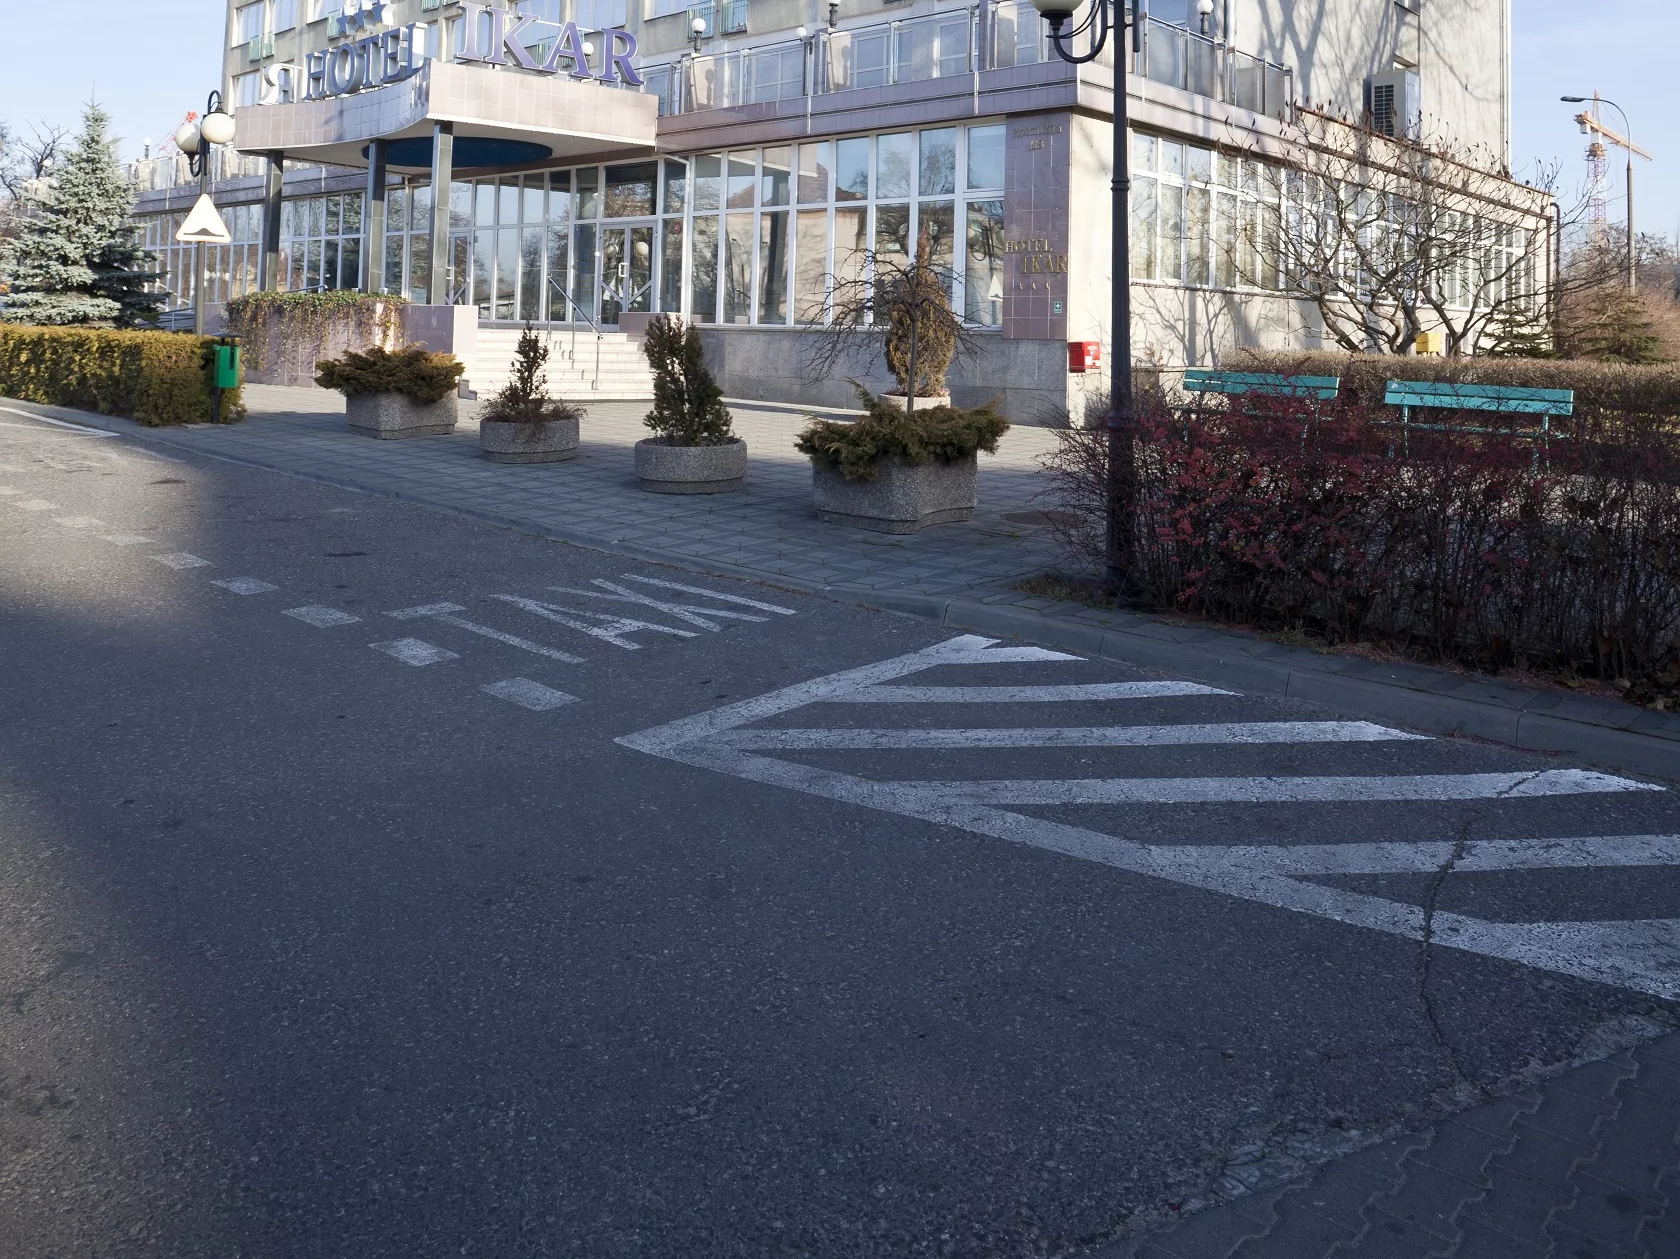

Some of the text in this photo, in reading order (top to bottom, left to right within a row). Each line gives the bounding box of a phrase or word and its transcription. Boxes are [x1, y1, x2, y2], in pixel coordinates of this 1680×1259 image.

[304, 22, 431, 100] HOTEL
[454, 2, 645, 86] IKAR
[1004, 238, 1052, 253] HOTEL
[1023, 254, 1068, 273] IKAR
